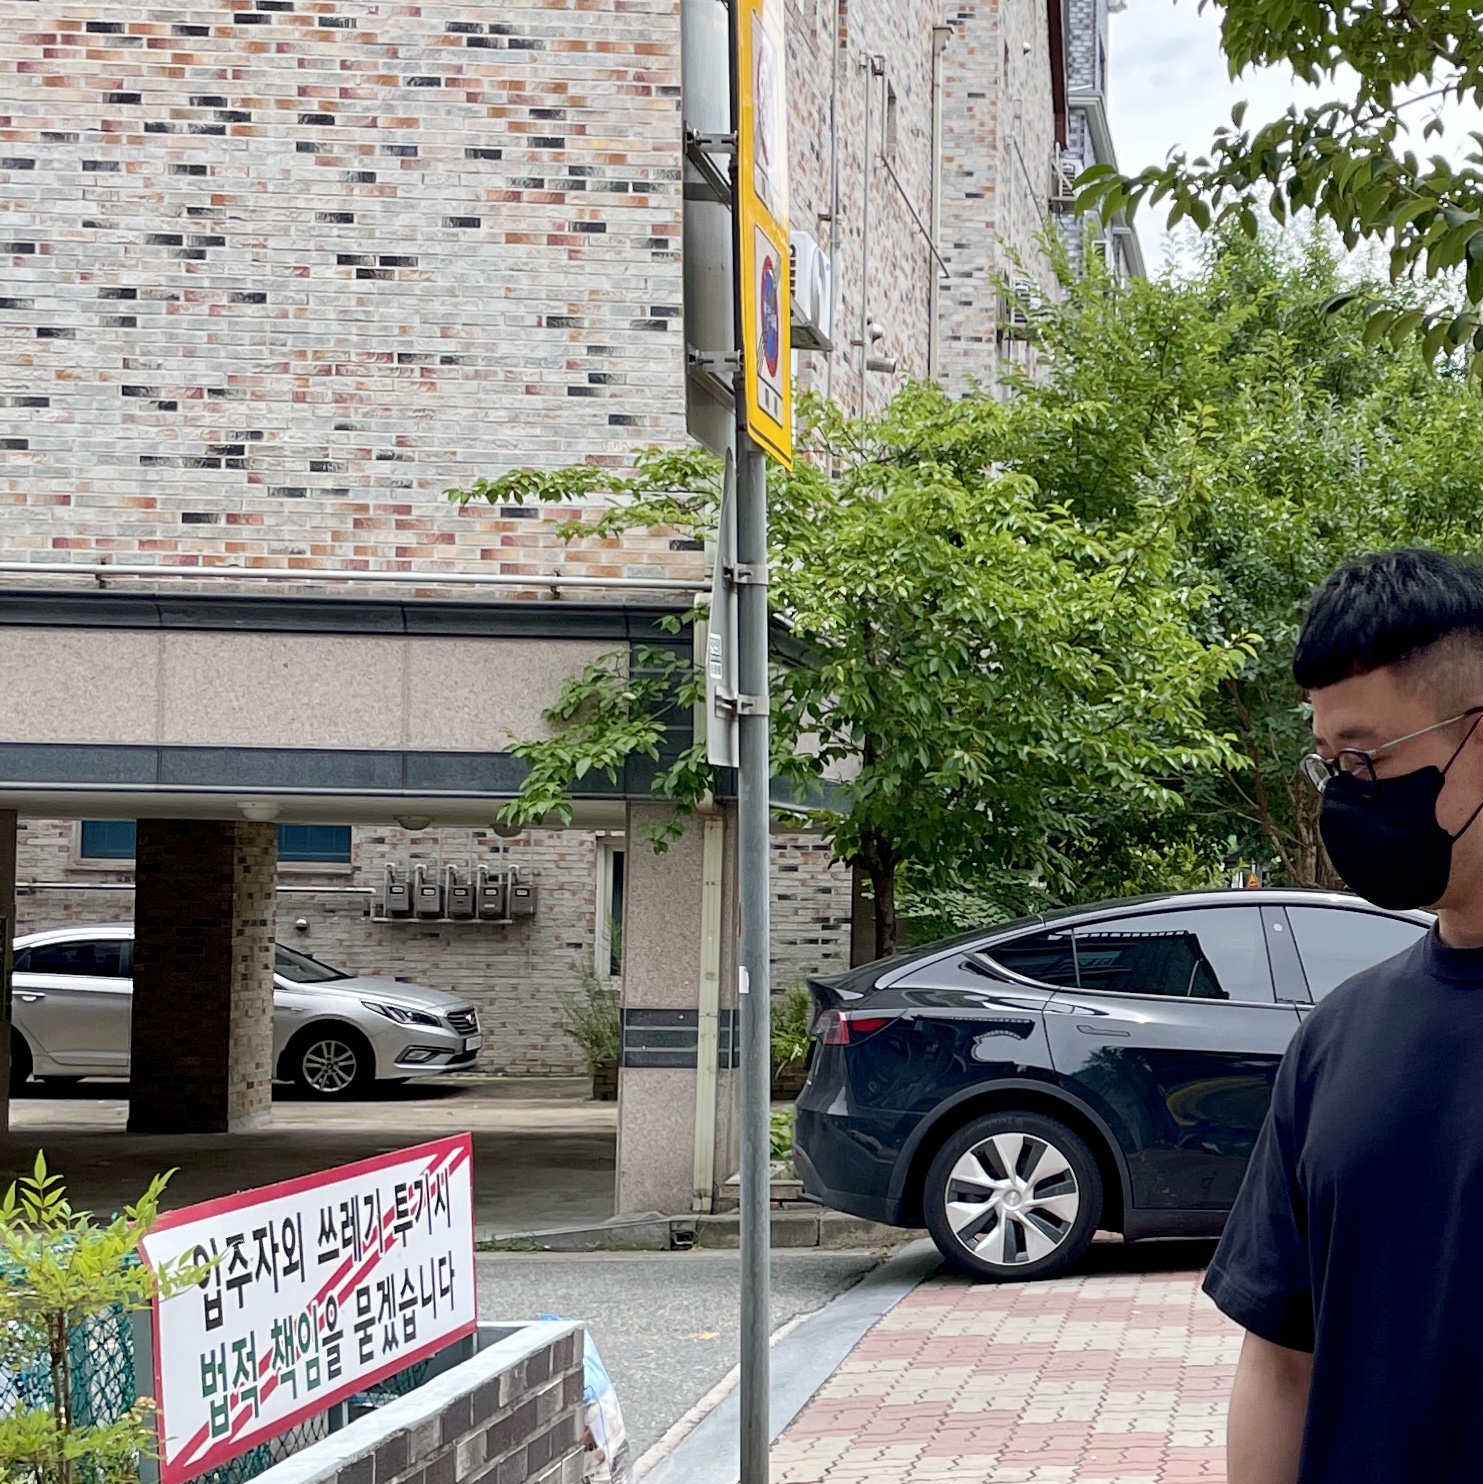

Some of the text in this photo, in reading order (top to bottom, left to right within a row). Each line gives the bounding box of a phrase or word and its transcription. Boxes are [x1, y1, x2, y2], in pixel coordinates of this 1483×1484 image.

[193, 1212, 306, 1332] 입주자외
[317, 1188, 384, 1265] 쓰레기
[200, 1250, 456, 1439] 법적 책임을 묻겠습니다
